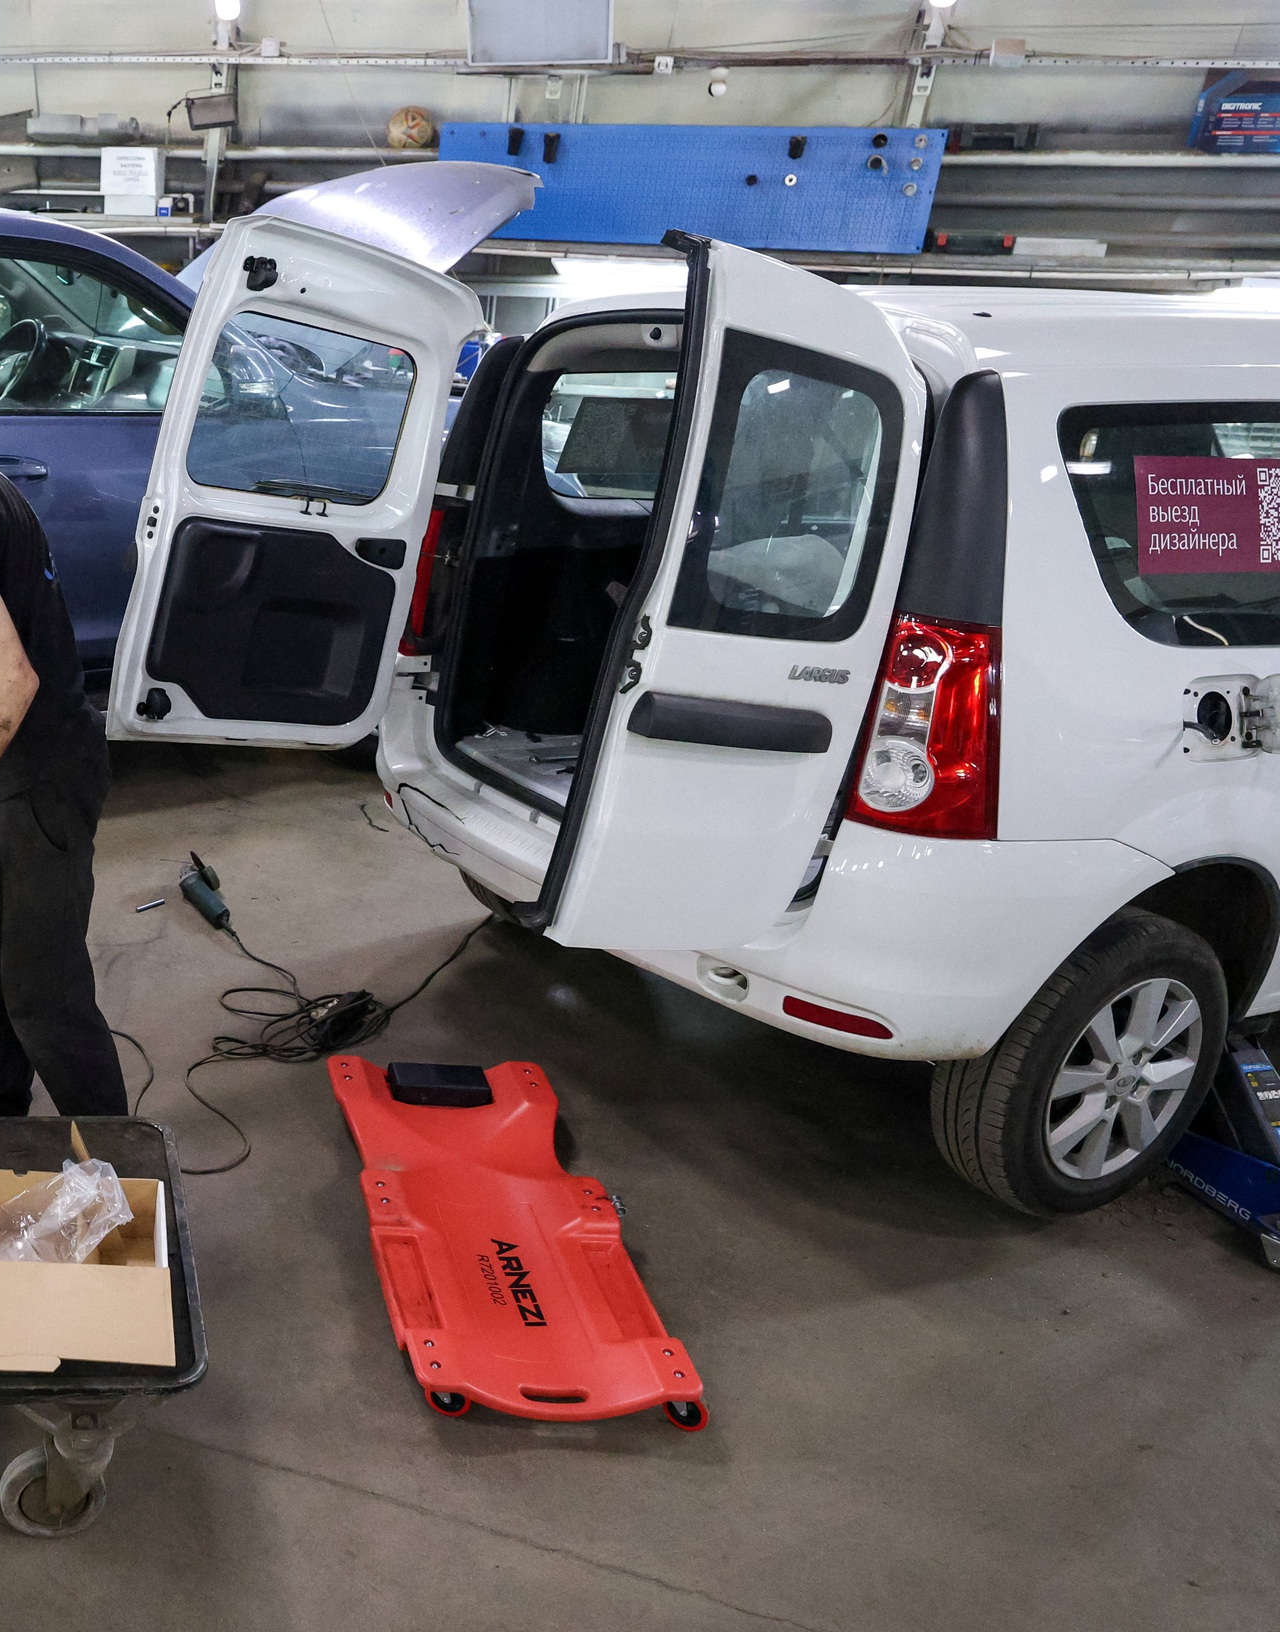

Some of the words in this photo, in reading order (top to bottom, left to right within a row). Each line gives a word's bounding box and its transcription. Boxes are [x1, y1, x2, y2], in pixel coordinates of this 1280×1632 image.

[1147, 474, 1247, 496] Бесплатный
[1149, 505, 1200, 527] выезд
[1149, 528, 1238, 557] дизайнера
[788, 664, 851, 685] LARGUS
[1164, 1158, 1253, 1221] NORDBERG
[476, 1254, 507, 1307] R7201002
[490, 1238, 548, 1327] ARNEZI
